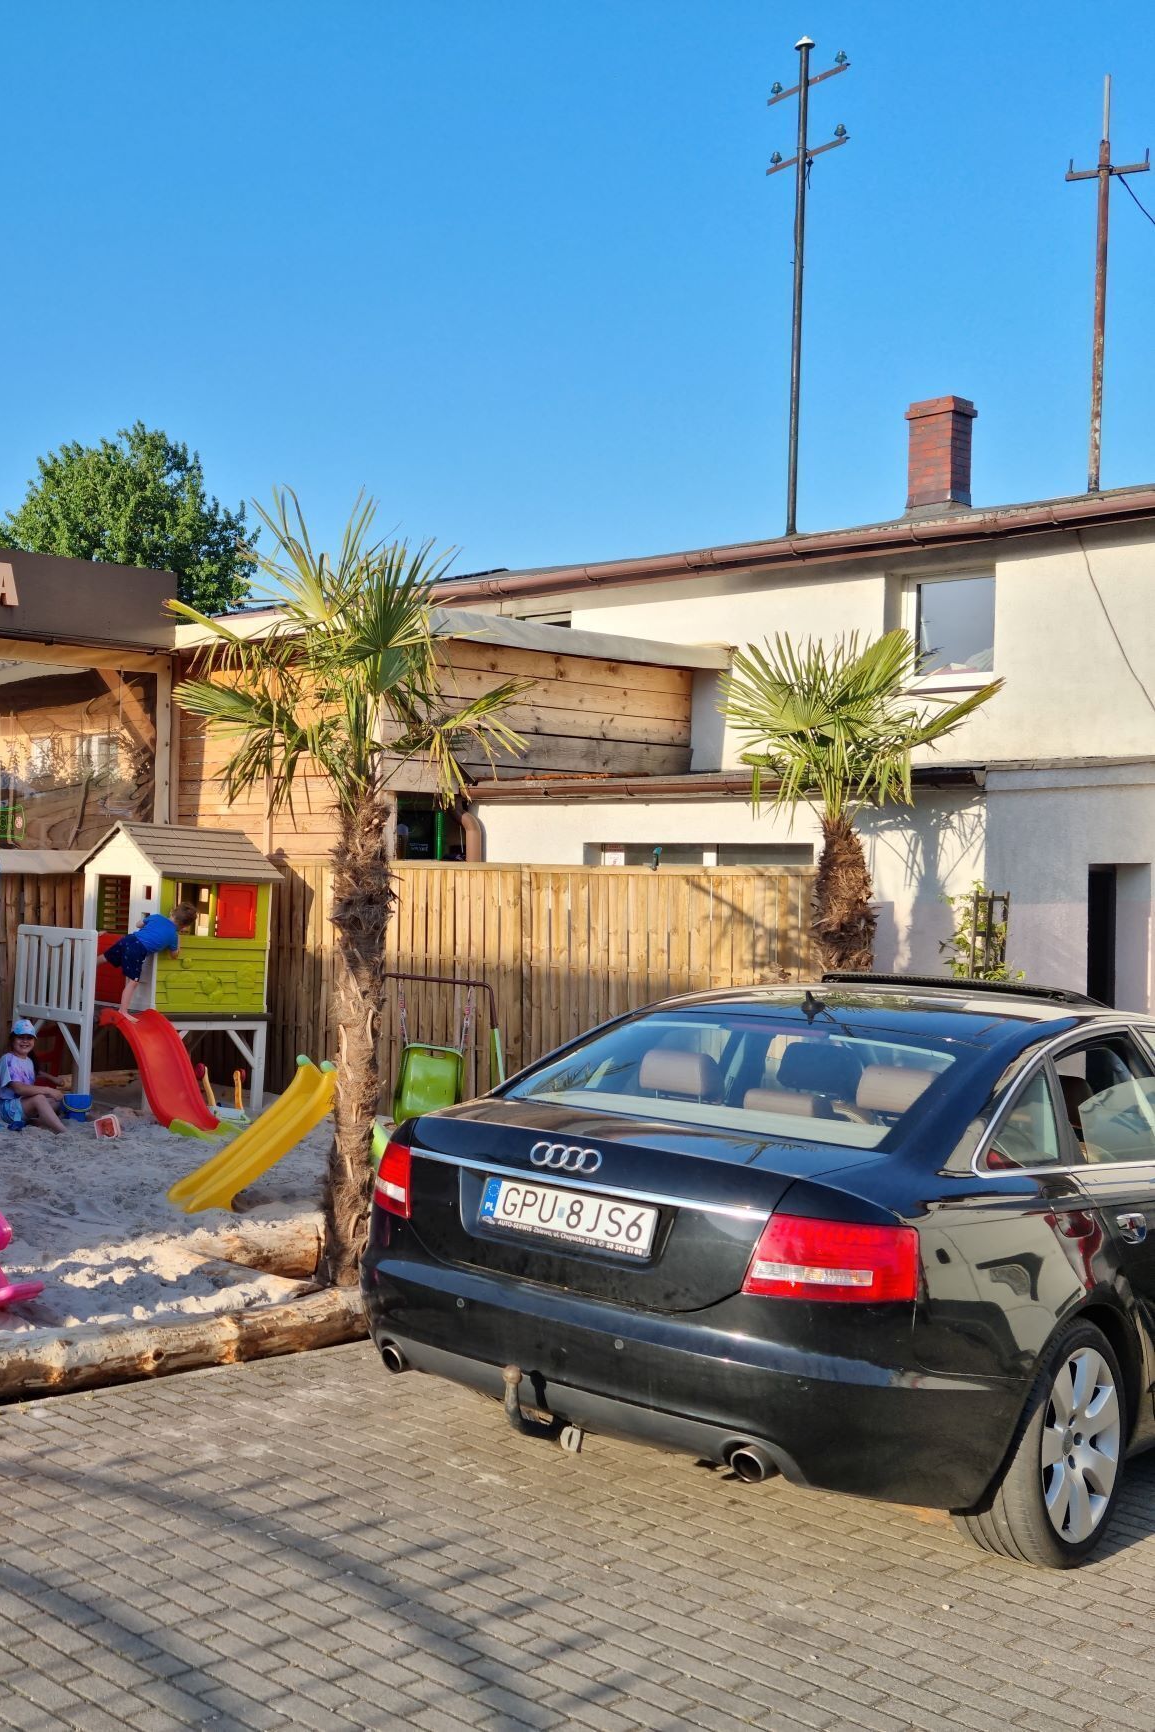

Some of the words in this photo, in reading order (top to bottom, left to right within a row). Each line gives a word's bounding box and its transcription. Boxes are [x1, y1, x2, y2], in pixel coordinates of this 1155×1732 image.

[484, 1201, 494, 1212] PL
[502, 1187, 559, 1224] GPU
[565, 1199, 646, 1243] 8JS6
